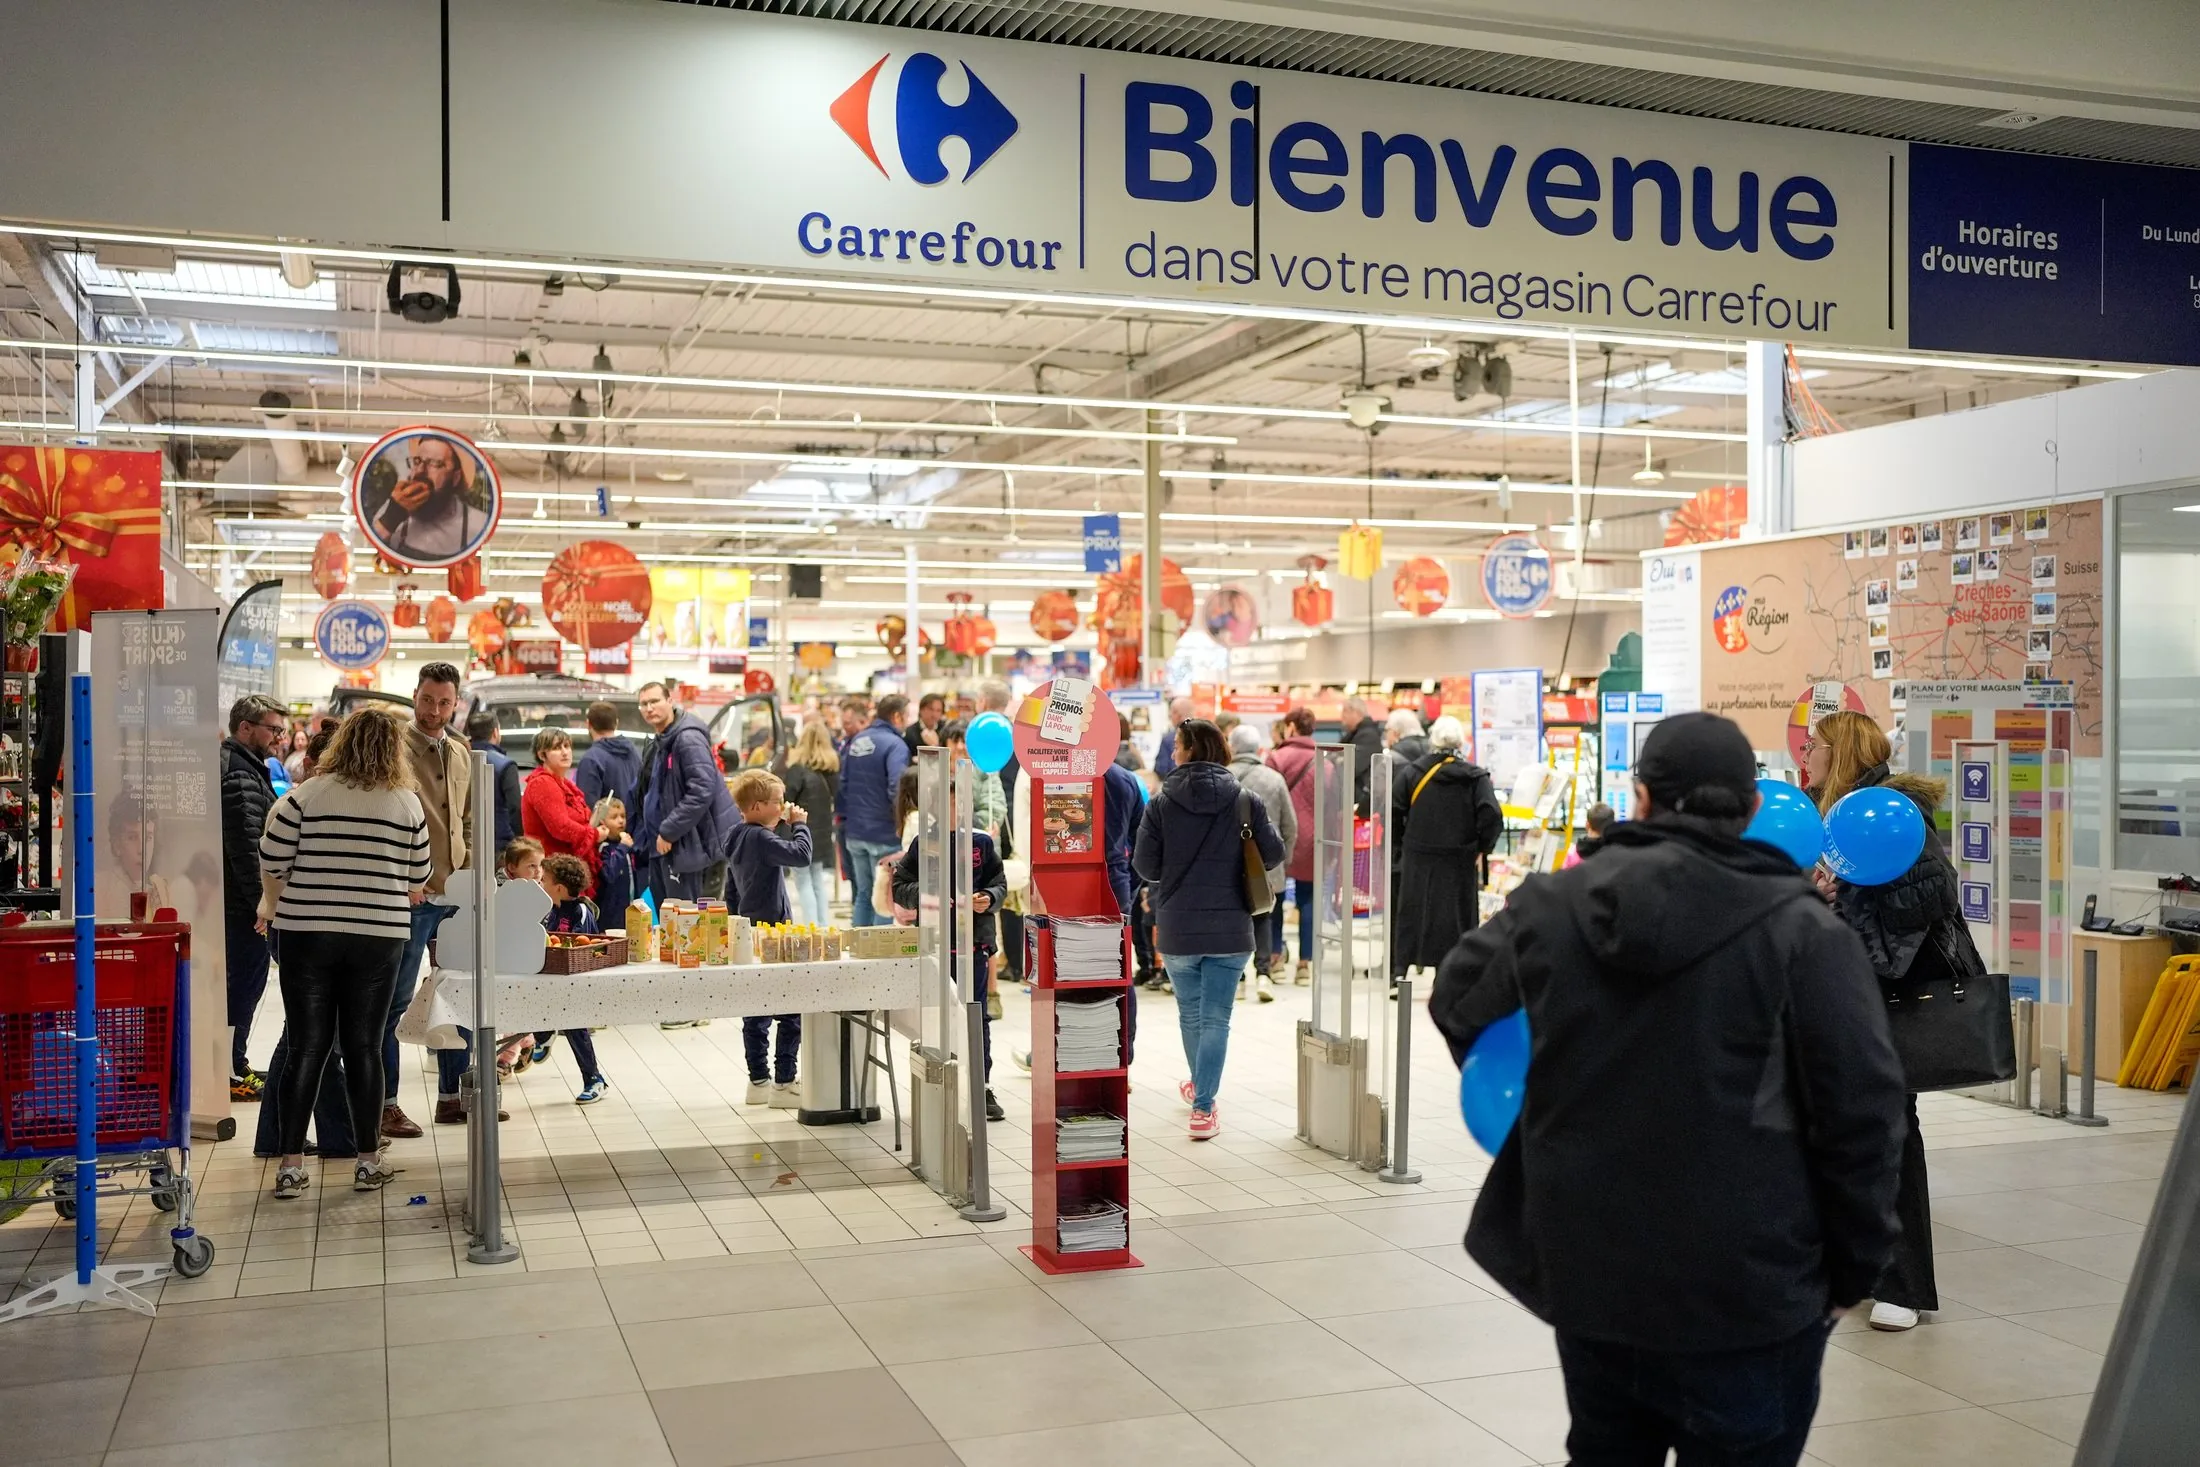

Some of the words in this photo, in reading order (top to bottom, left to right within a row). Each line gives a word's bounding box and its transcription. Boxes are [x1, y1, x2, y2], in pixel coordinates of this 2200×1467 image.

[1124, 80, 1838, 261] Bienvenue
[1959, 220, 2058, 250] Horaires
[2143, 225, 2161, 240] Du
[798, 212, 1062, 270] Carrefour
[1922, 246, 2058, 280] d'ouverture
[1124, 231, 1255, 285] dans
[1270, 251, 1409, 298] votre
[1424, 266, 1611, 320] magasin
[1622, 274, 1838, 331] Carrefour
[2064, 560, 2099, 575] Suisse
[331, 618, 358, 631] ACT
[1747, 606, 1789, 635] Région
[330, 641, 367, 655] FOOD
[1981, 684, 2022, 692] MAGASIN
[1050, 700, 1084, 715] PROMOS
[1720, 694, 1768, 715] partenaires
[1813, 702, 1839, 711] PROMOS
[1046, 713, 1063, 723] DANS
[1045, 720, 1053, 729] LA
[1053, 723, 1073, 733] POCHE
